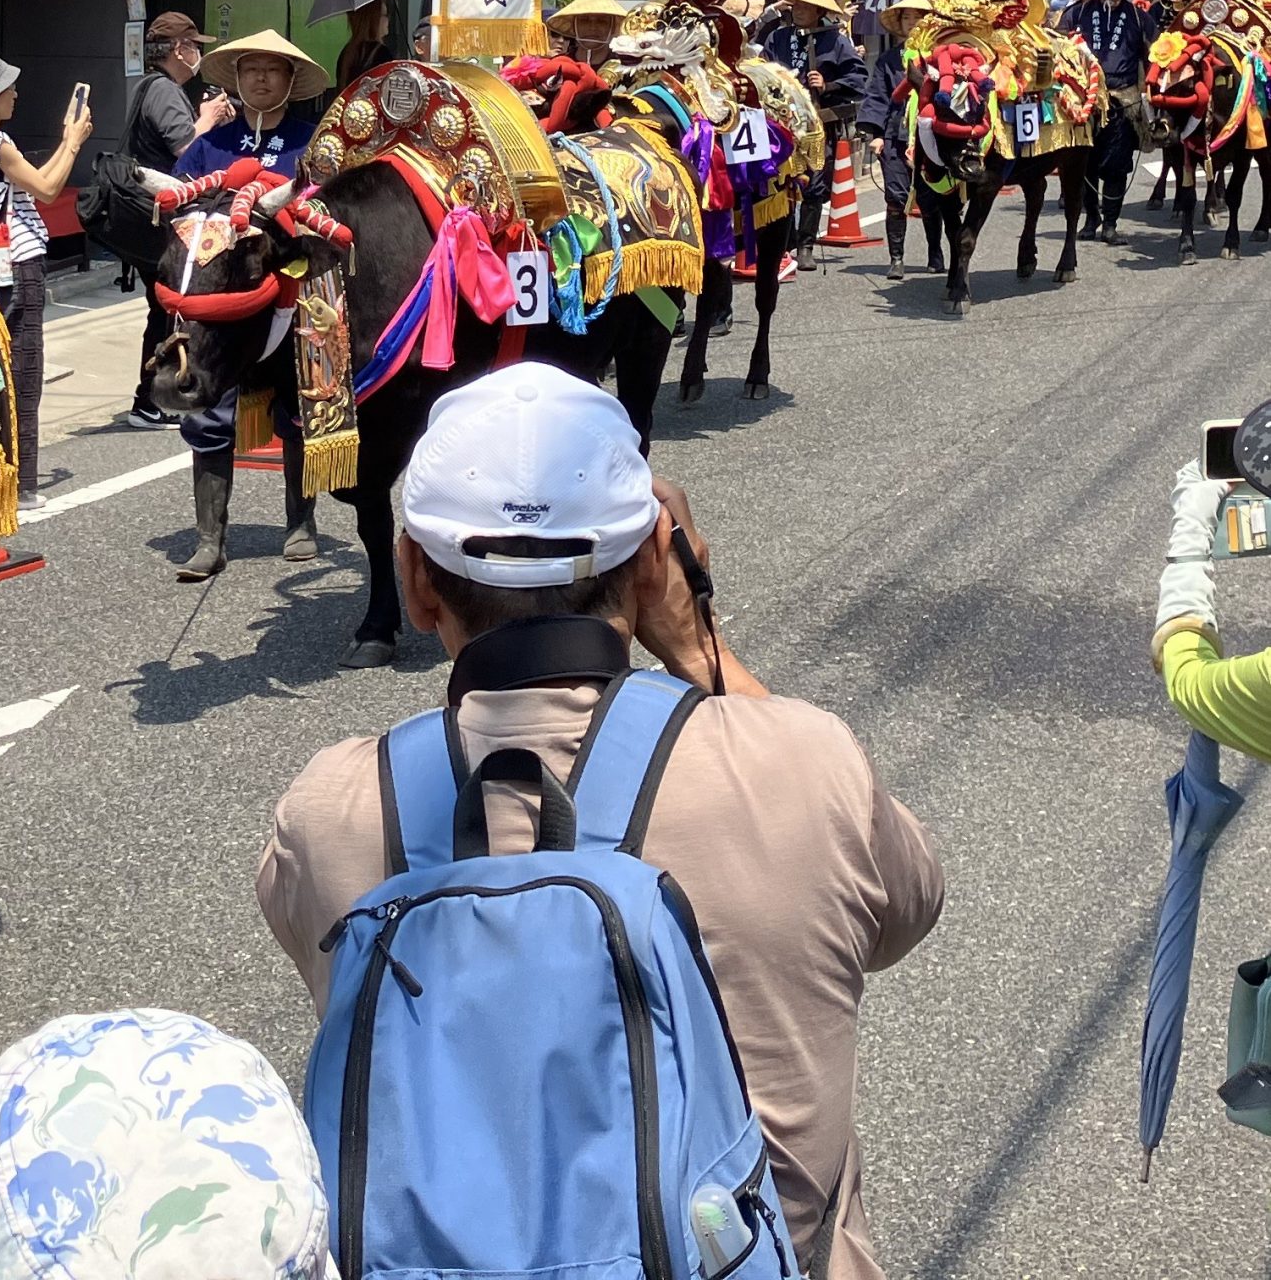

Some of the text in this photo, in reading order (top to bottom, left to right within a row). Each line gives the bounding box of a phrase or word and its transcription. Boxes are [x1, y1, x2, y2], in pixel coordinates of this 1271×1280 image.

[732, 119, 757, 155] 4
[1021, 110, 1033, 137] 5
[515, 264, 538, 318] 3
[502, 502, 551, 513] Reebok
